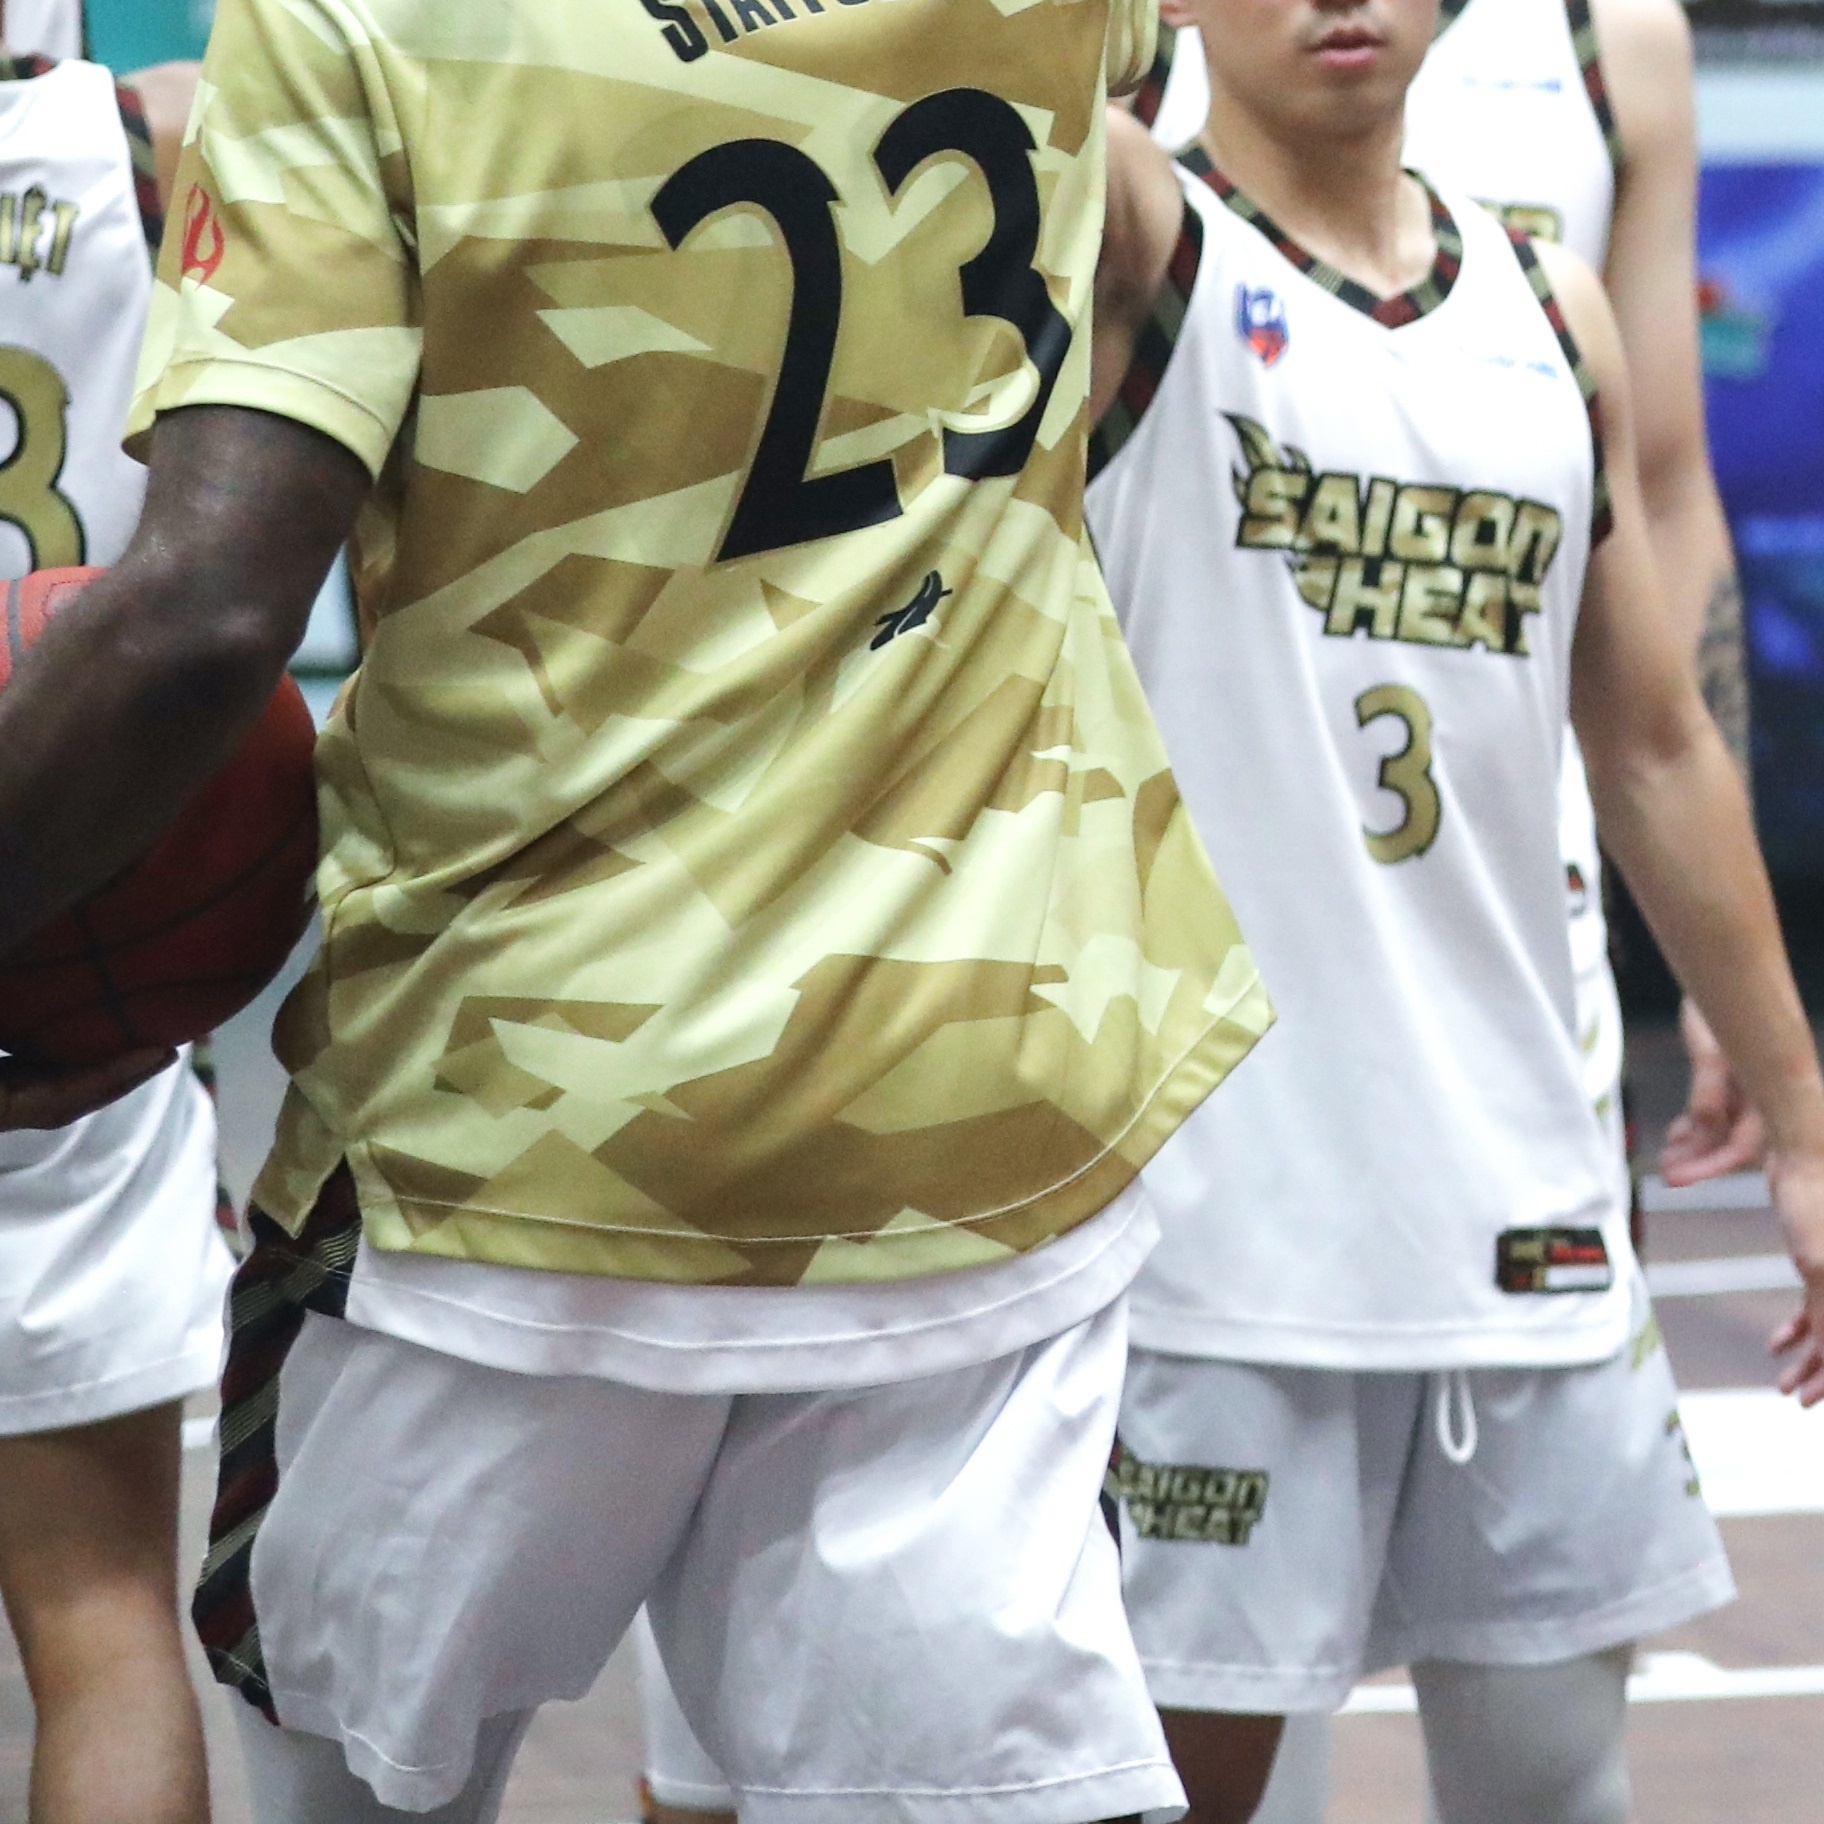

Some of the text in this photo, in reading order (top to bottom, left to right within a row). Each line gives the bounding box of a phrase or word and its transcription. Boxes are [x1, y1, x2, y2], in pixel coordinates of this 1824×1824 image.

[649, 87, 1073, 563] 23
[1236, 468, 1562, 583] SAIGON
[1324, 555, 1541, 658] HEAT
[1354, 682, 1442, 865] 3
